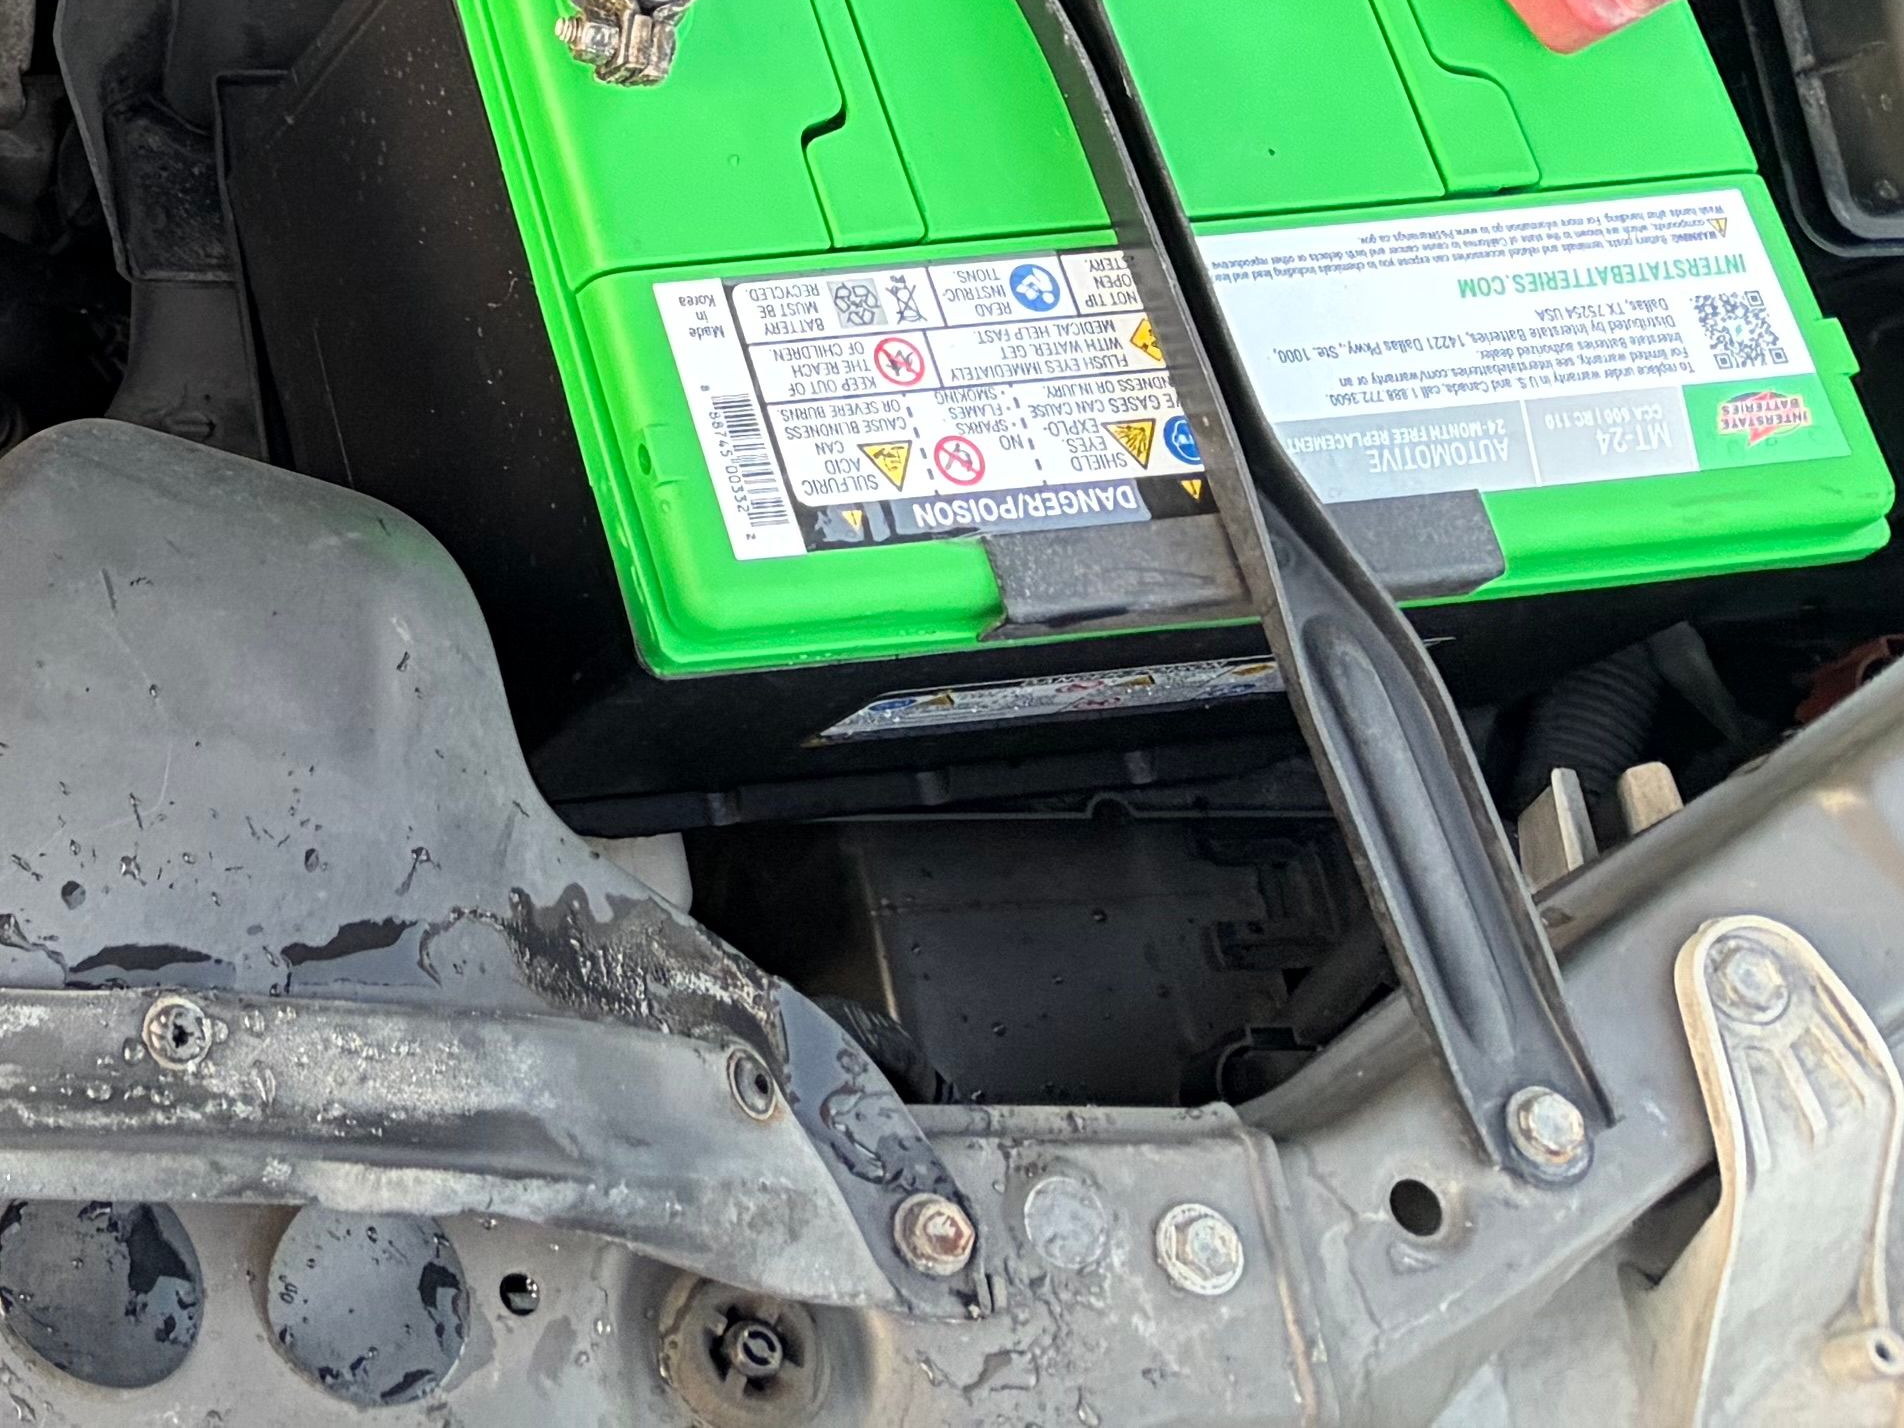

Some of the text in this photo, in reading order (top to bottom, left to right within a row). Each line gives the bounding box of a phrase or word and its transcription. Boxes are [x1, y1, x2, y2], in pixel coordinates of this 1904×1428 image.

[953, 268, 1001, 284] TIONS.
[1455, 251, 1747, 299] INTERSTATEBATTERIES.COM
[678, 294, 716, 307] Korea
[749, 283, 820, 302] RECYCLED.
[942, 284, 1007, 302] INSTRUC-
[1085, 293, 1107, 308] TIP
[757, 301, 819, 319] MUST BE
[974, 301, 1012, 317] READ
[1606, 302, 1626, 316] TX
[1624, 297, 1669, 313] Dallas,
[695, 310, 709, 322] in
[1534, 307, 1562, 322] USA
[688, 325, 725, 340] Made
[764, 317, 825, 336] BATTERY
[977, 319, 1116, 345] MEDICAL HELP FAST.
[1528, 323, 1589, 340] Interstate
[1590, 319, 1606, 334] by
[1607, 314, 1676, 334] Distributed
[773, 341, 865, 361] OF CHILDREN.
[1000, 336, 1124, 360] WITH WATER. GET
[1382, 337, 1424, 354] Dallas
[1426, 334, 1466, 350] 14221
[791, 359, 872, 378] THE REACH
[951, 353, 1129, 382] FLUSH EYES IMMEDIATELY
[1678, 361, 1696, 374] To
[788, 376, 876, 397] KEEP OUT OF
[1042, 382, 1094, 399] INJURY.
[1095, 380, 1116, 394] OR
[1490, 378, 1512, 392] and
[934, 387, 997, 405] SMOKING
[1108, 394, 1161, 414] GASES
[780, 399, 901, 422] OR SEVERE BURNS.
[948, 403, 1003, 420] FLAMES
[1027, 402, 1073, 419] CAUSE
[1074, 399, 1105, 414] CAN
[1633, 403, 1663, 421] CCA
[1720, 398, 1800, 415] BATTERIES
[1543, 411, 1571, 430] 110
[1572, 409, 1592, 427] RC
[1720, 411, 1808, 430] INTERSTATE
[784, 416, 907, 440] CAUSE BLINDNESS
[955, 419, 1008, 436] SPARKS
[1043, 418, 1100, 437] EXPLO-
[1285, 417, 1506, 454] 24-MONTH FREE REPLACEMENT
[998, 434, 1024, 451] NO
[1061, 435, 1107, 454] EYES.
[1593, 422, 1671, 453] MT-24
[815, 440, 845, 456] CAN
[1364, 435, 1509, 472] AUTOMOTIVE
[824, 457, 860, 475] ACID
[1070, 452, 1128, 472] SHIELD
[801, 474, 879, 496] SULFURIC
[910, 482, 1137, 527] DANGER/POISON
